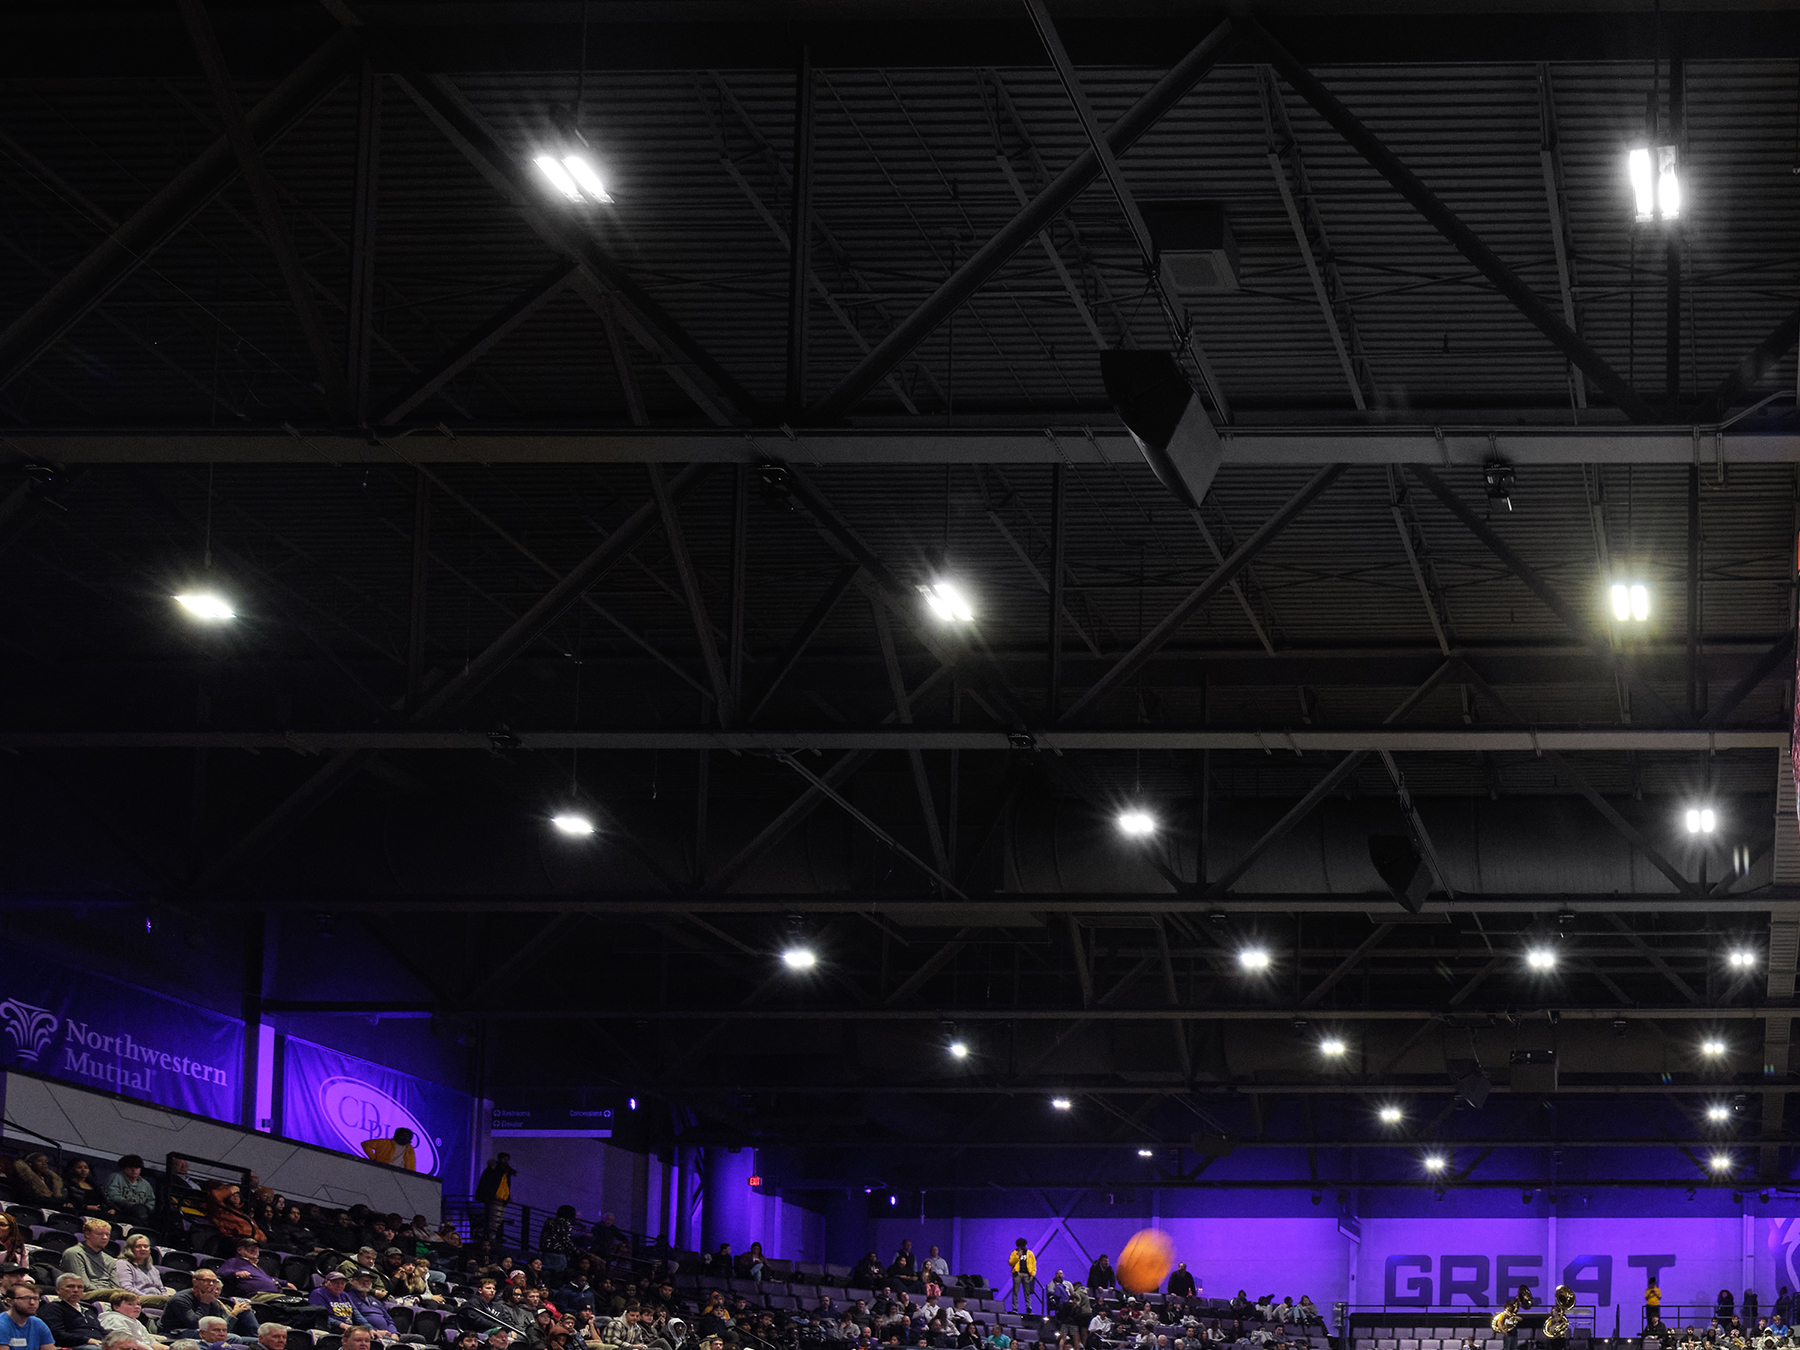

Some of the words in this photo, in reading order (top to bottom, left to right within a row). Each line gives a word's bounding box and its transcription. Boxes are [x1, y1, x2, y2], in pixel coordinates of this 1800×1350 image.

[63, 1047, 152, 1093] Mutual
[65, 1019, 228, 1087] Northwestern
[1385, 1254, 1676, 1307] GREAT
